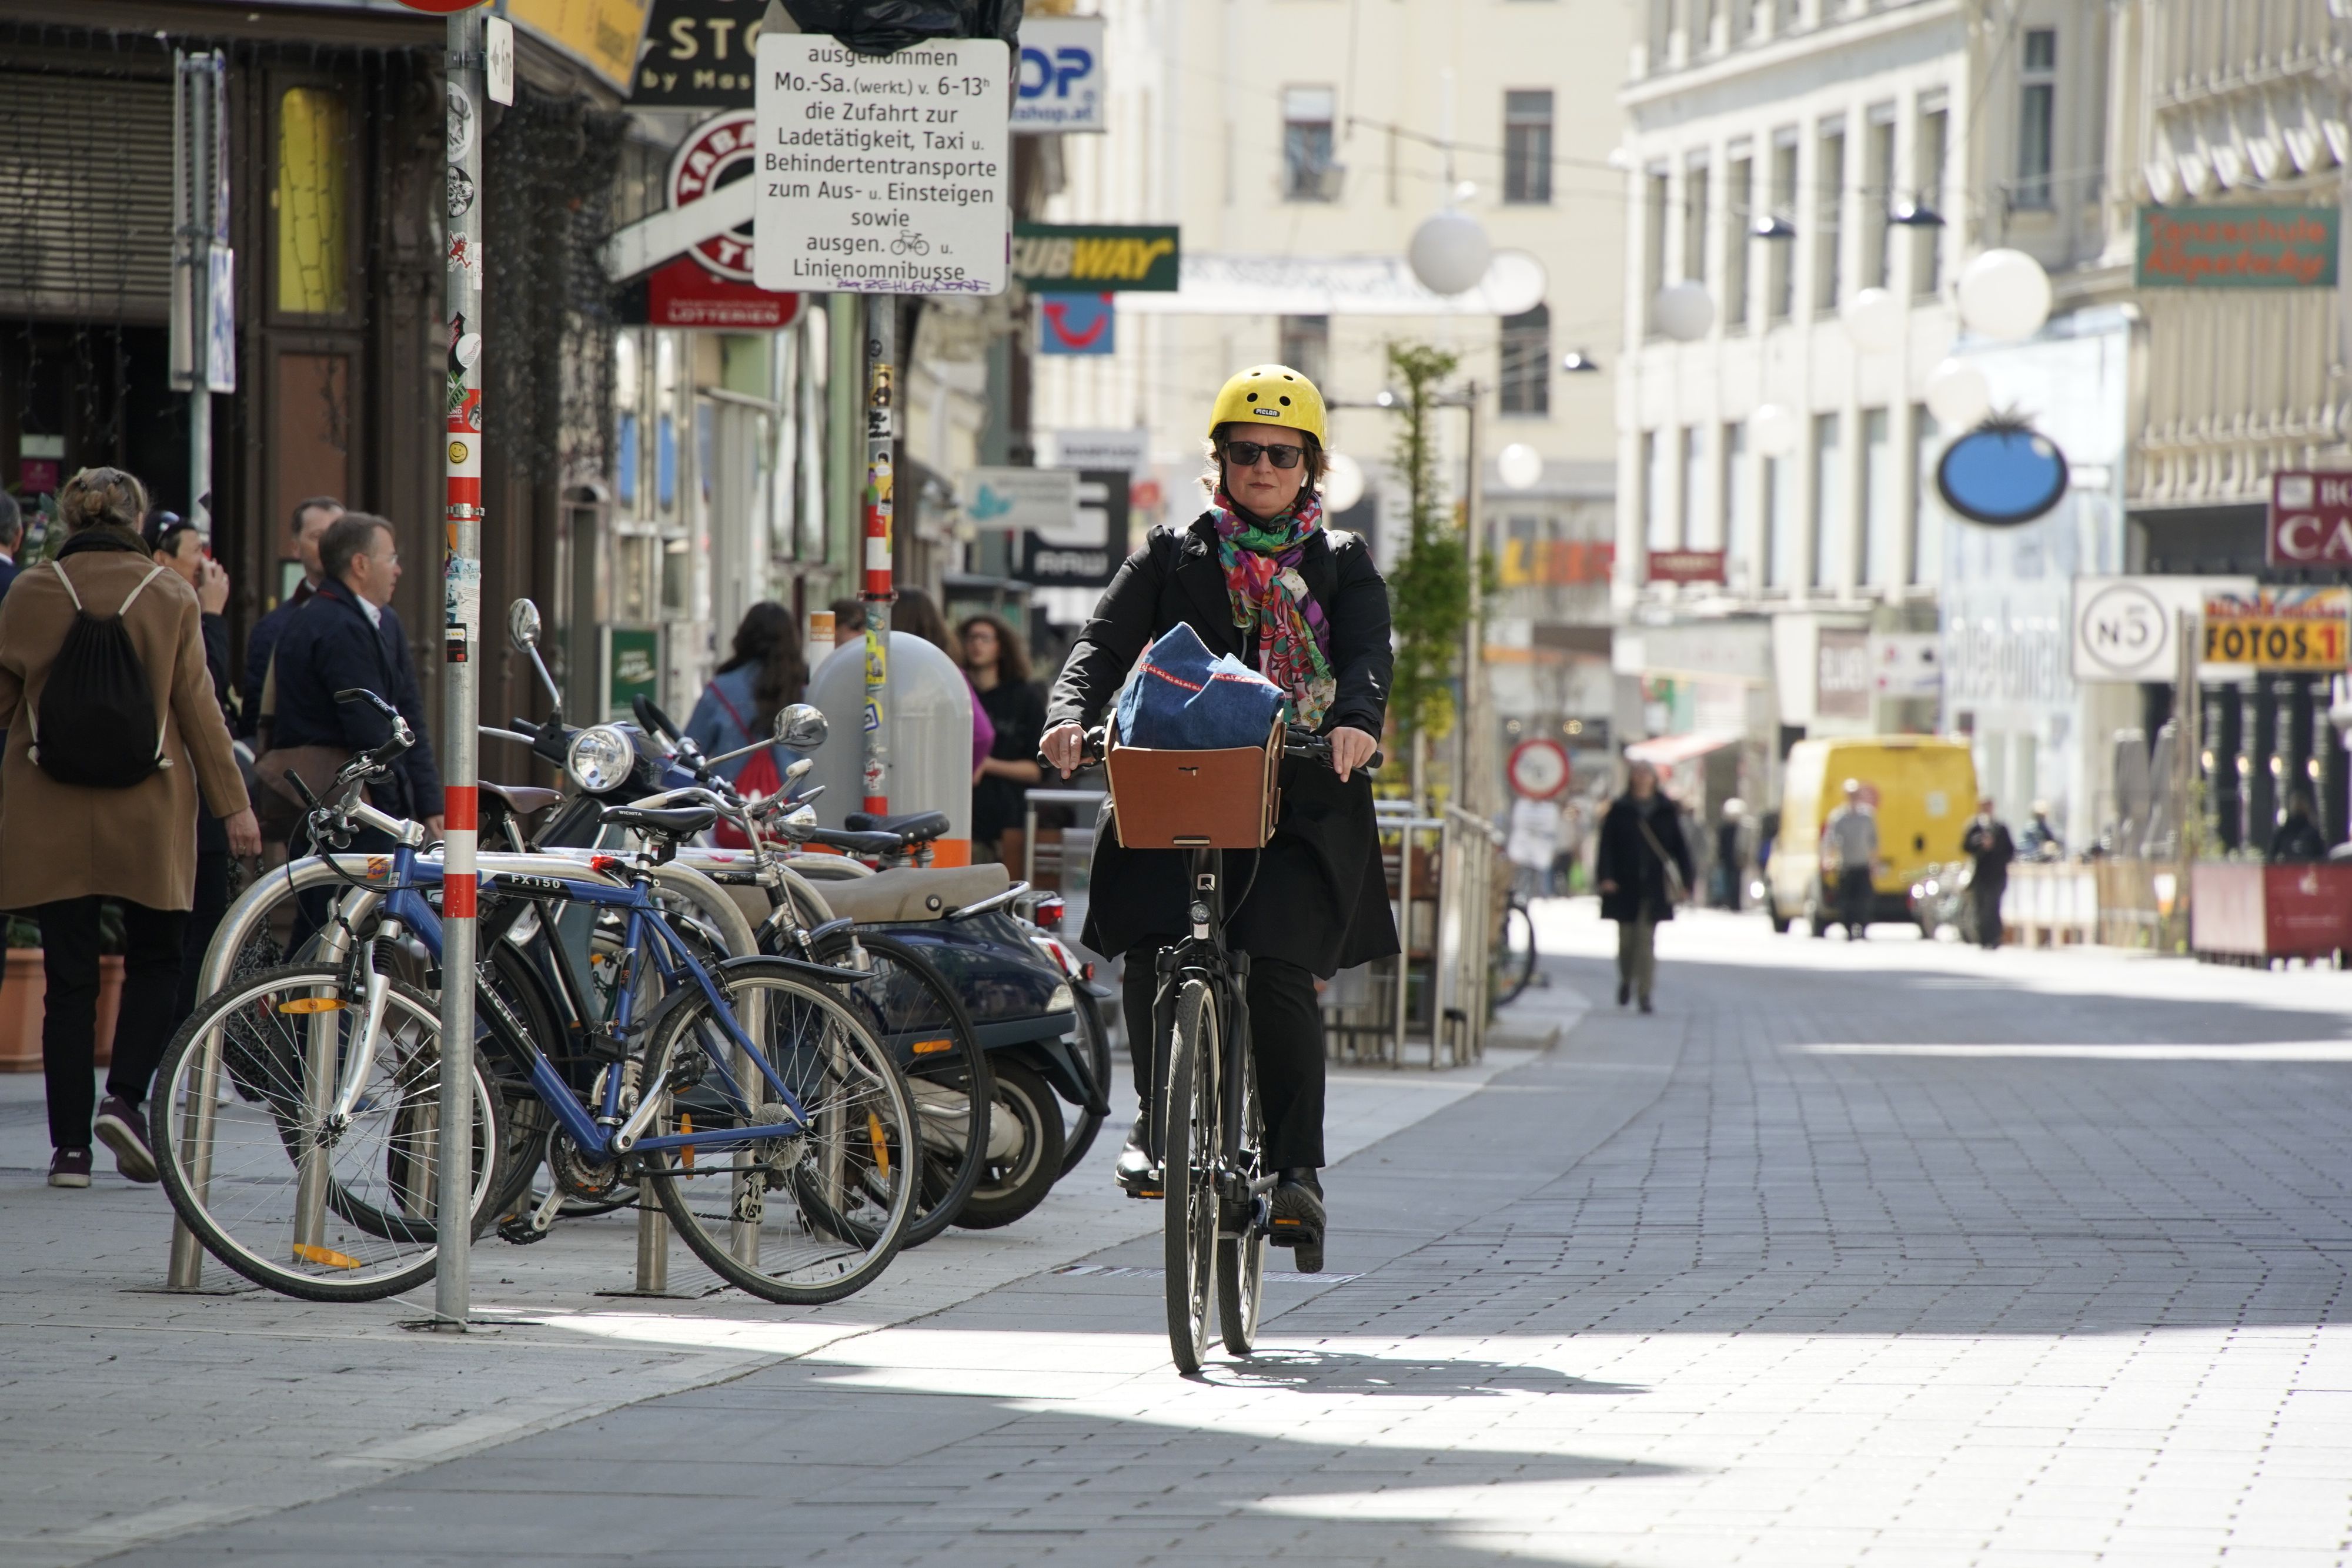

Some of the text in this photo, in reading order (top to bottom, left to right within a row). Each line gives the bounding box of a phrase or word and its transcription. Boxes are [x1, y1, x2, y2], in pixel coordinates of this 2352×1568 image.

[642, 69, 677, 91] by
[918, 85, 929, 95] v.
[805, 101, 958, 123] die Zufahrt zur
[779, 127, 984, 152] Ladetätigkeit, Taxi u.
[766, 153, 997, 179] Behindertentransporte
[768, 180, 993, 207] zum Aus- u. Einsteigen
[851, 208, 910, 227] sowie
[806, 236, 953, 255] ausgen. u.
[794, 258, 965, 280] Linienomnibusse
[2206, 627, 2307, 660] FOTOS
[512, 874, 562, 890] FX 150
